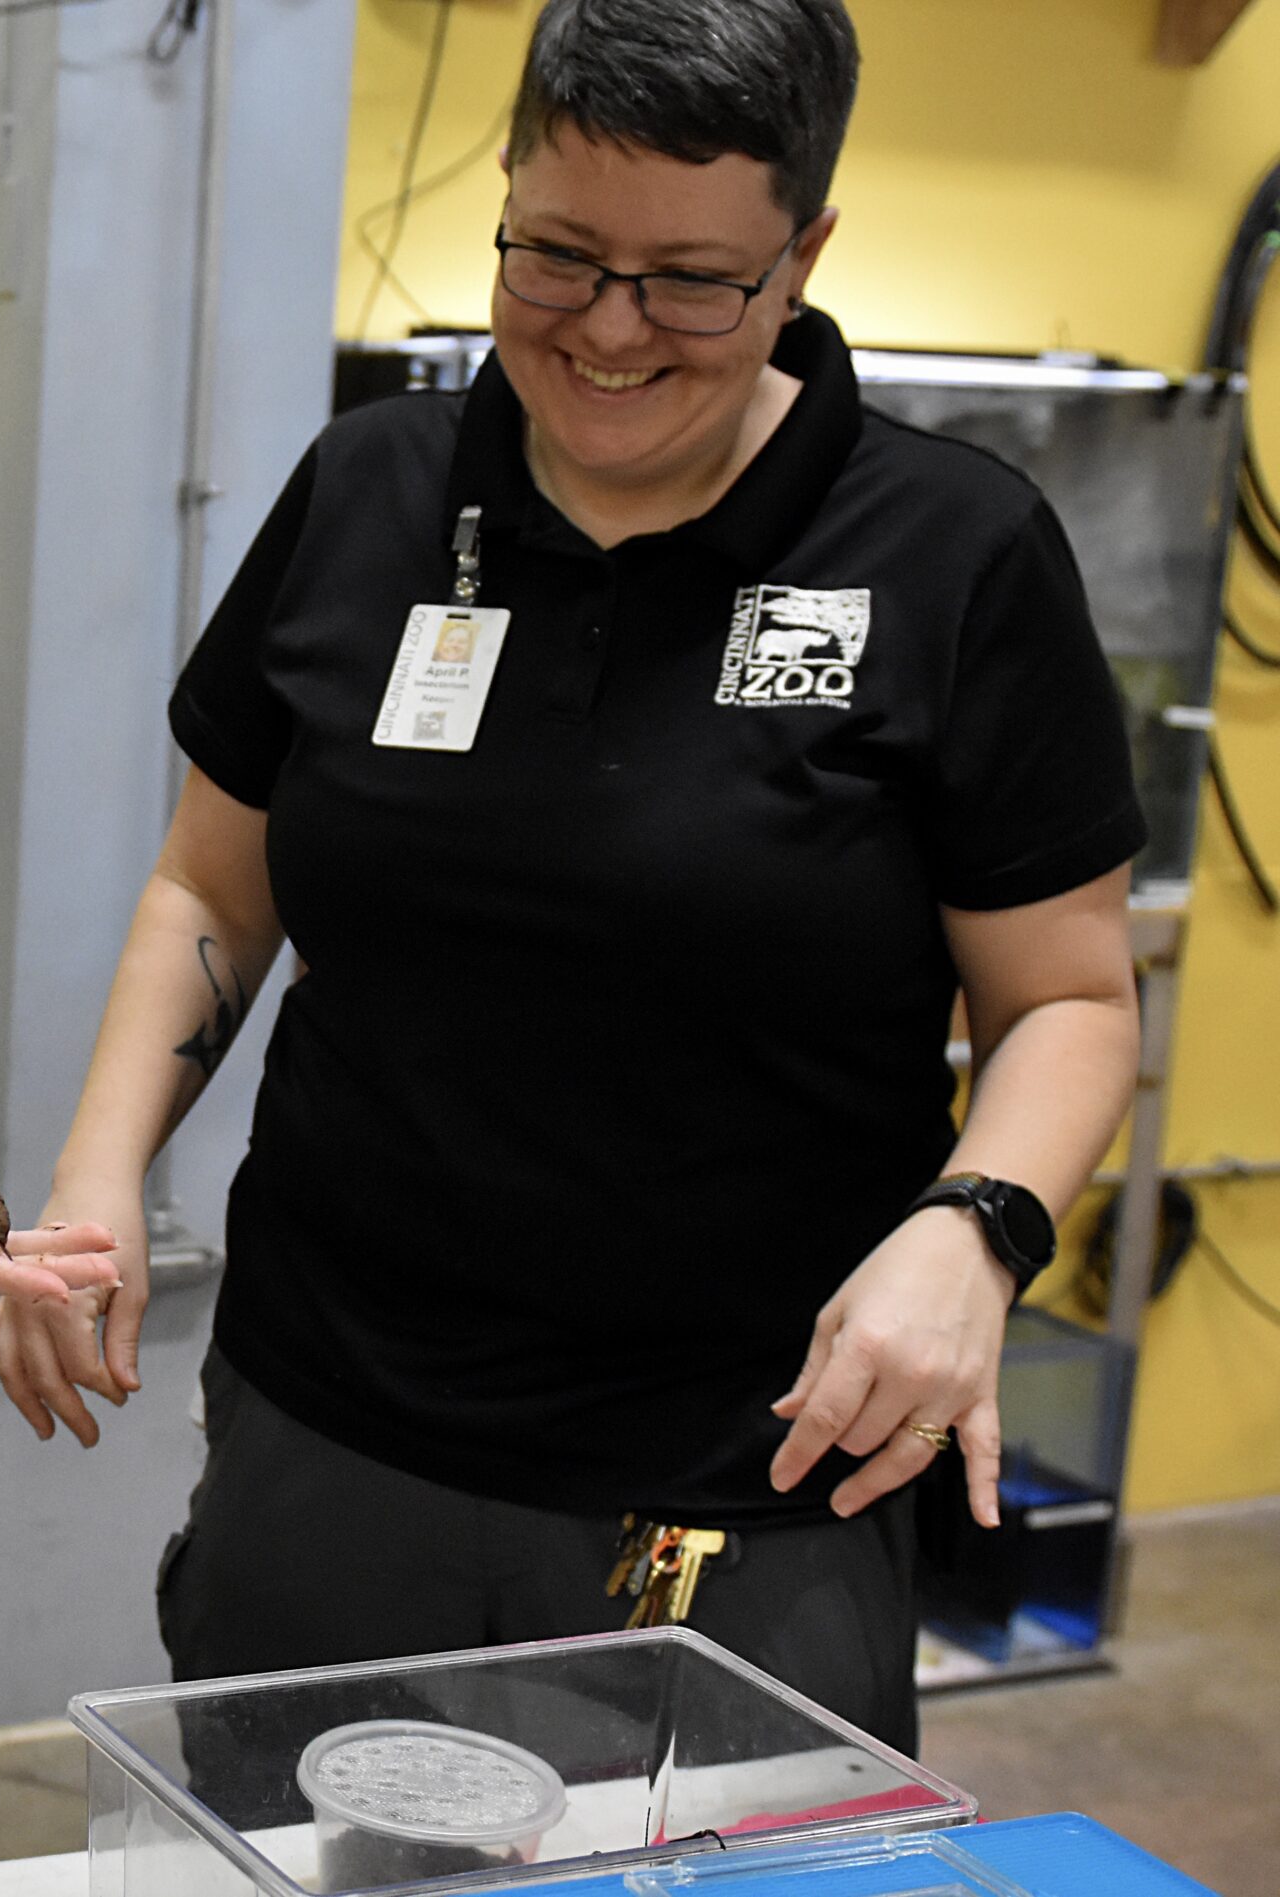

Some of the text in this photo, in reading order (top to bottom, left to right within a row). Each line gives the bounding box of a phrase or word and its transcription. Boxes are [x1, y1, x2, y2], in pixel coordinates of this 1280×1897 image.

[377, 610, 426, 739] CINCINNATI ZOO
[424, 666, 457, 678] April
[714, 586, 757, 705] CINCINNATI
[740, 665, 854, 699] ZOO
